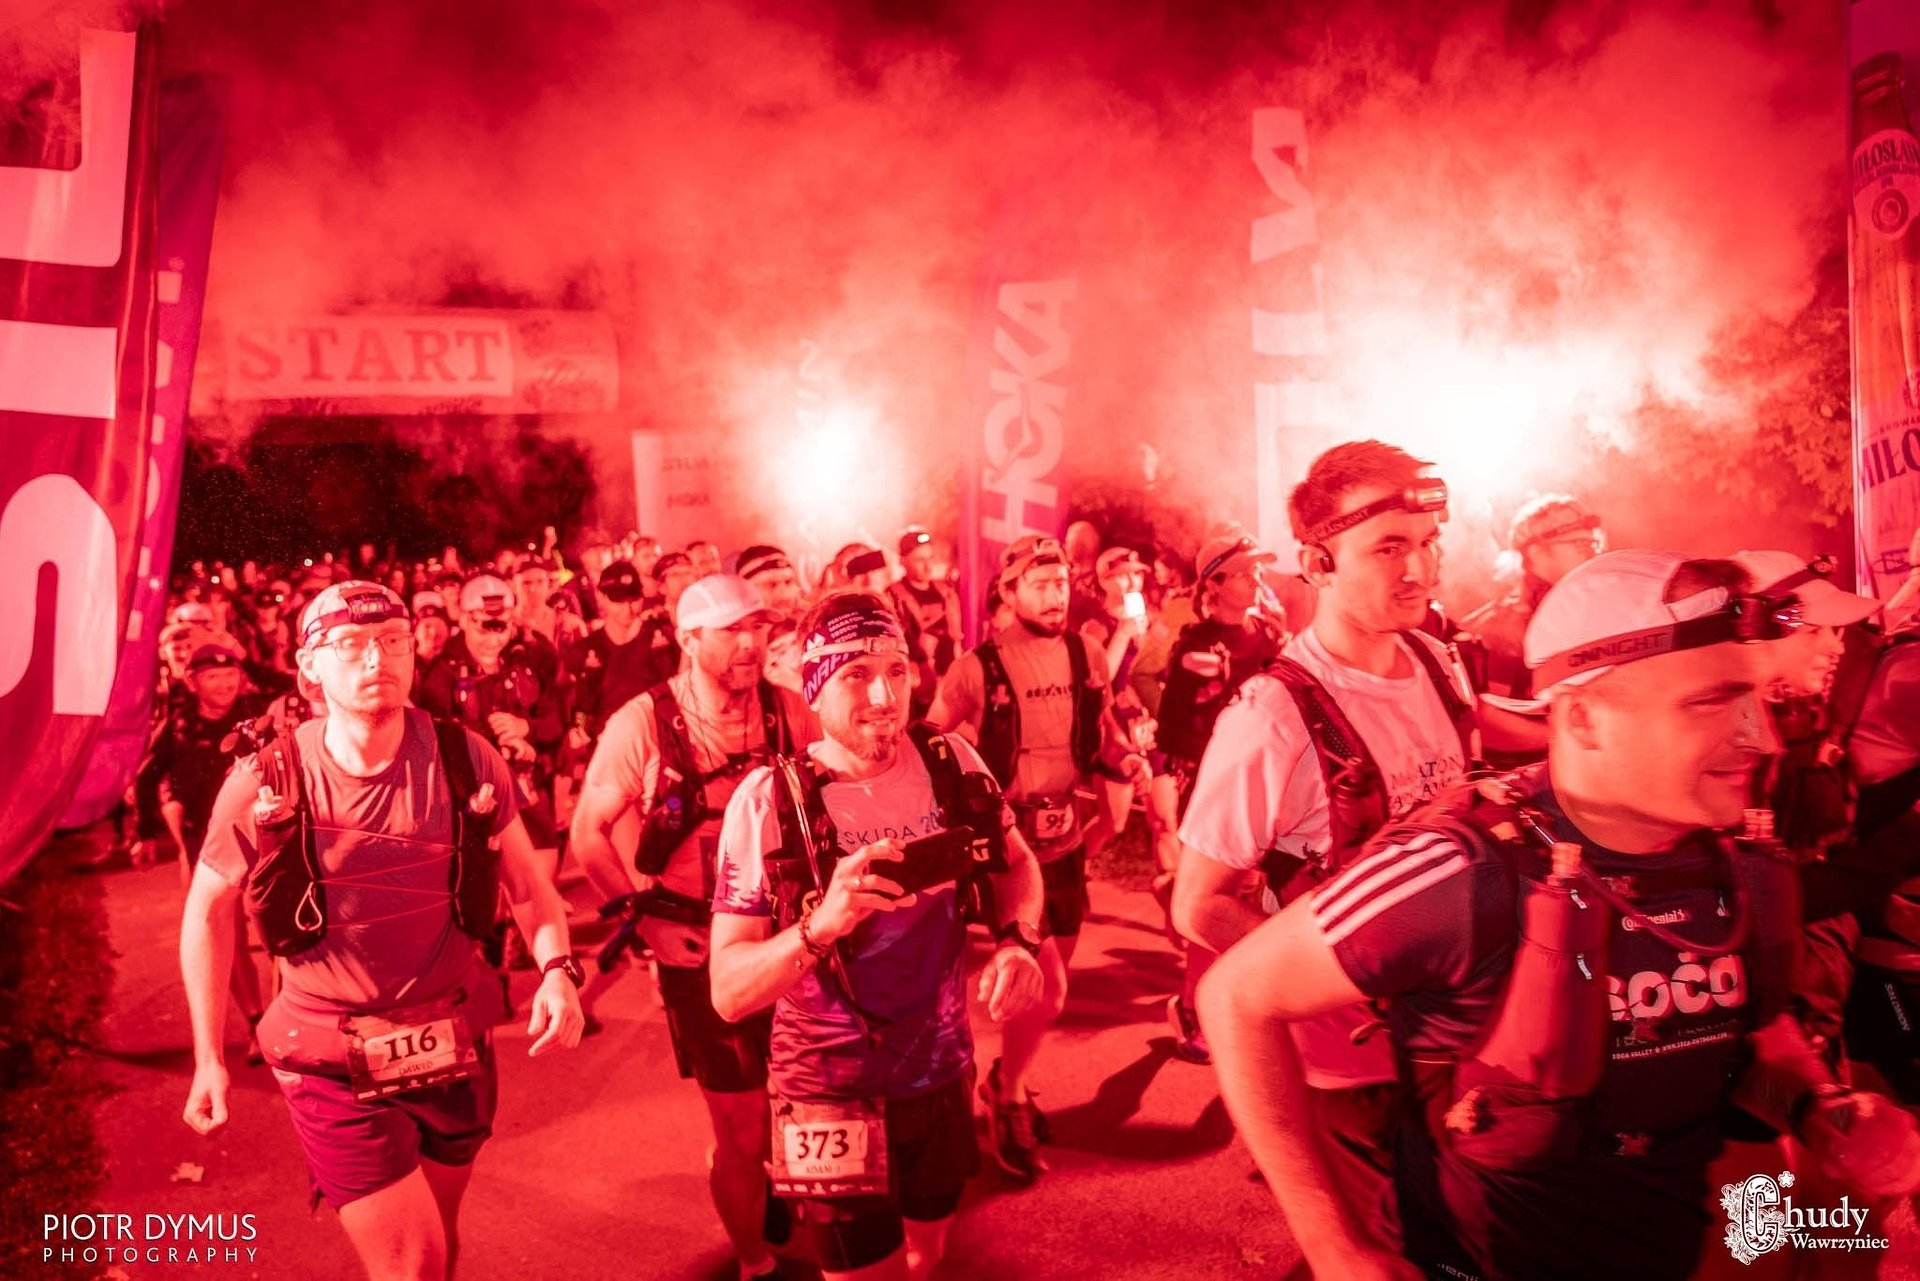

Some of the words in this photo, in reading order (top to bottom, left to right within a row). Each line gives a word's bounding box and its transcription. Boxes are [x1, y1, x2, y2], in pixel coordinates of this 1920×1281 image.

[236, 325, 500, 384] START
[982, 279, 1079, 545] HOKA
[837, 825, 917, 846] SKIDA
[384, 1025, 437, 1062] 116
[796, 1128, 850, 1160] 373
